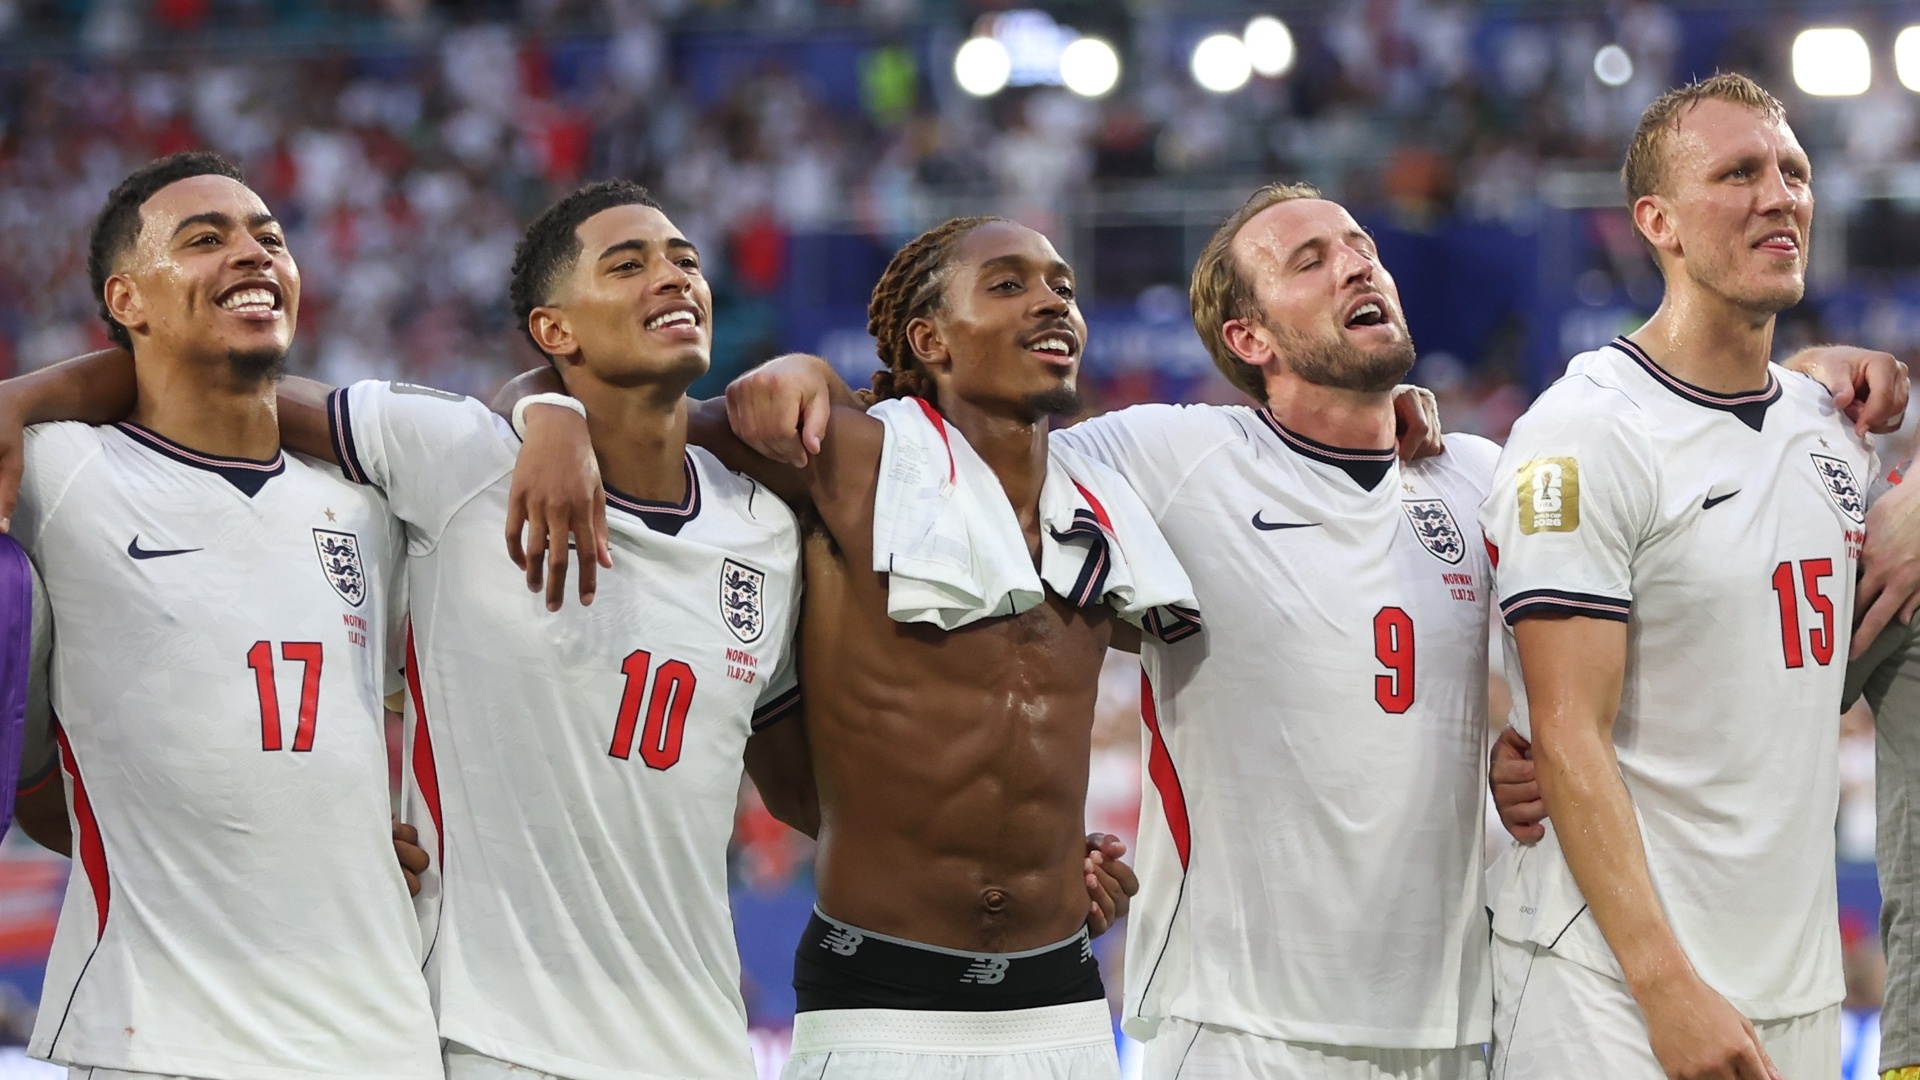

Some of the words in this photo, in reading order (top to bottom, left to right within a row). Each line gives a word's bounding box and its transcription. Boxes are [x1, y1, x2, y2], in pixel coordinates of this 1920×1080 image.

[1533, 518, 1562, 528] 2026
[1442, 573, 1473, 587] NORWAY
[1772, 558, 1834, 669] 15
[725, 647, 758, 669] NORWAY
[726, 664, 756, 684] 11.07.26
[1373, 606, 1415, 714] 9
[247, 640, 323, 752] 17
[608, 649, 697, 771] 10
